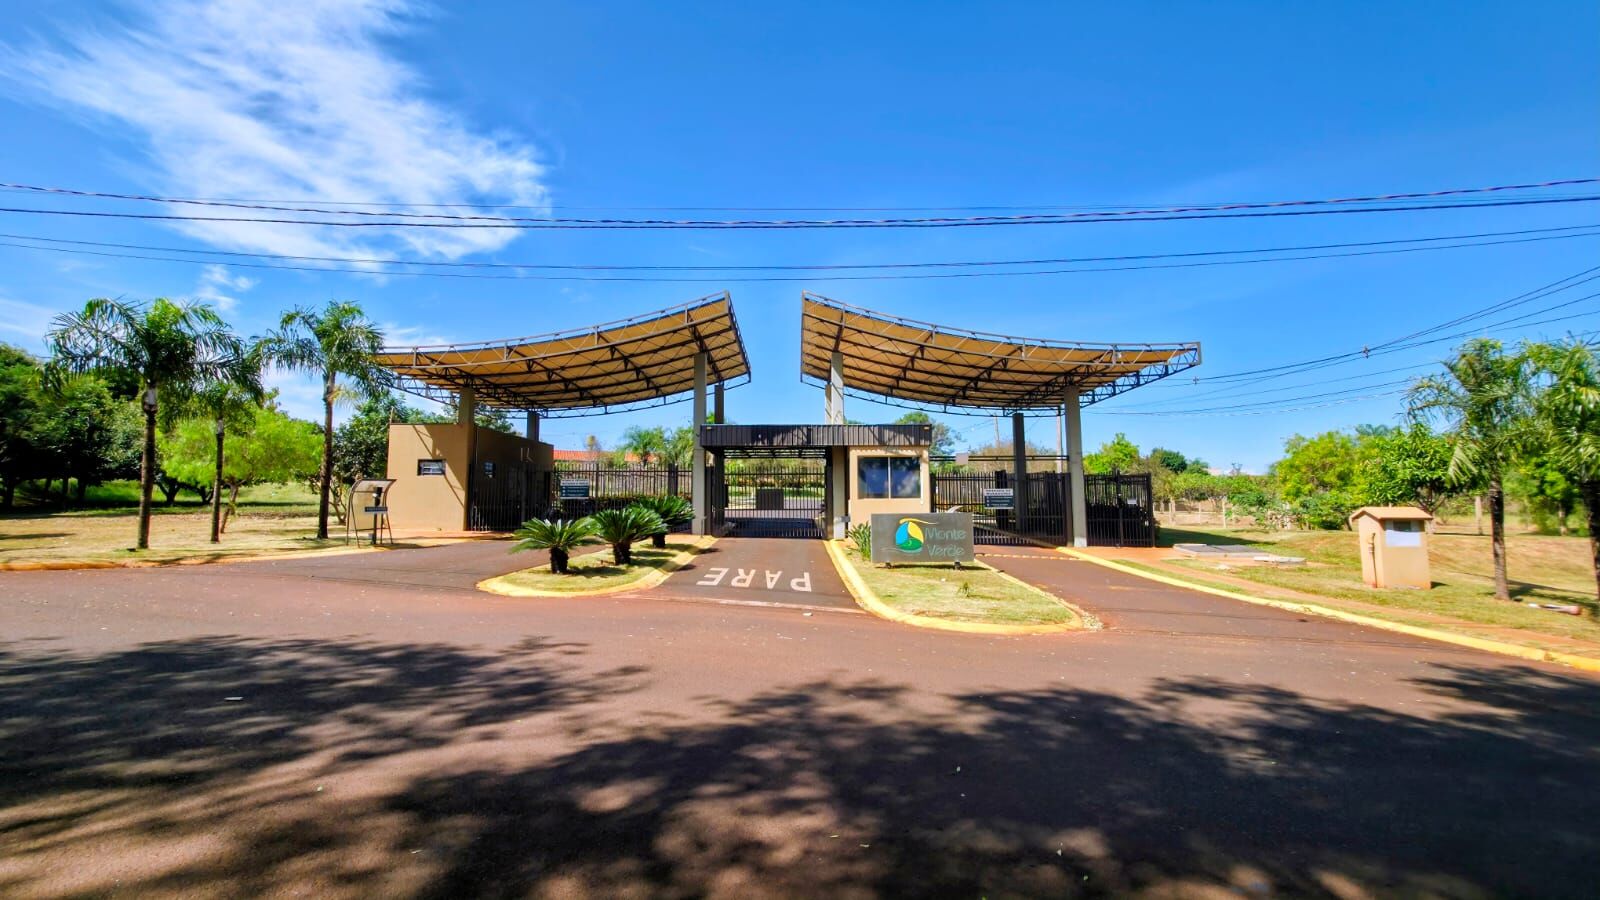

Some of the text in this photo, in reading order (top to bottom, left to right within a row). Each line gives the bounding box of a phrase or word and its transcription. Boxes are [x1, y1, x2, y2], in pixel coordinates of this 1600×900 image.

[925, 527, 966, 540] Monte
[927, 543, 965, 557] Verde
[695, 567, 812, 593] PARE
